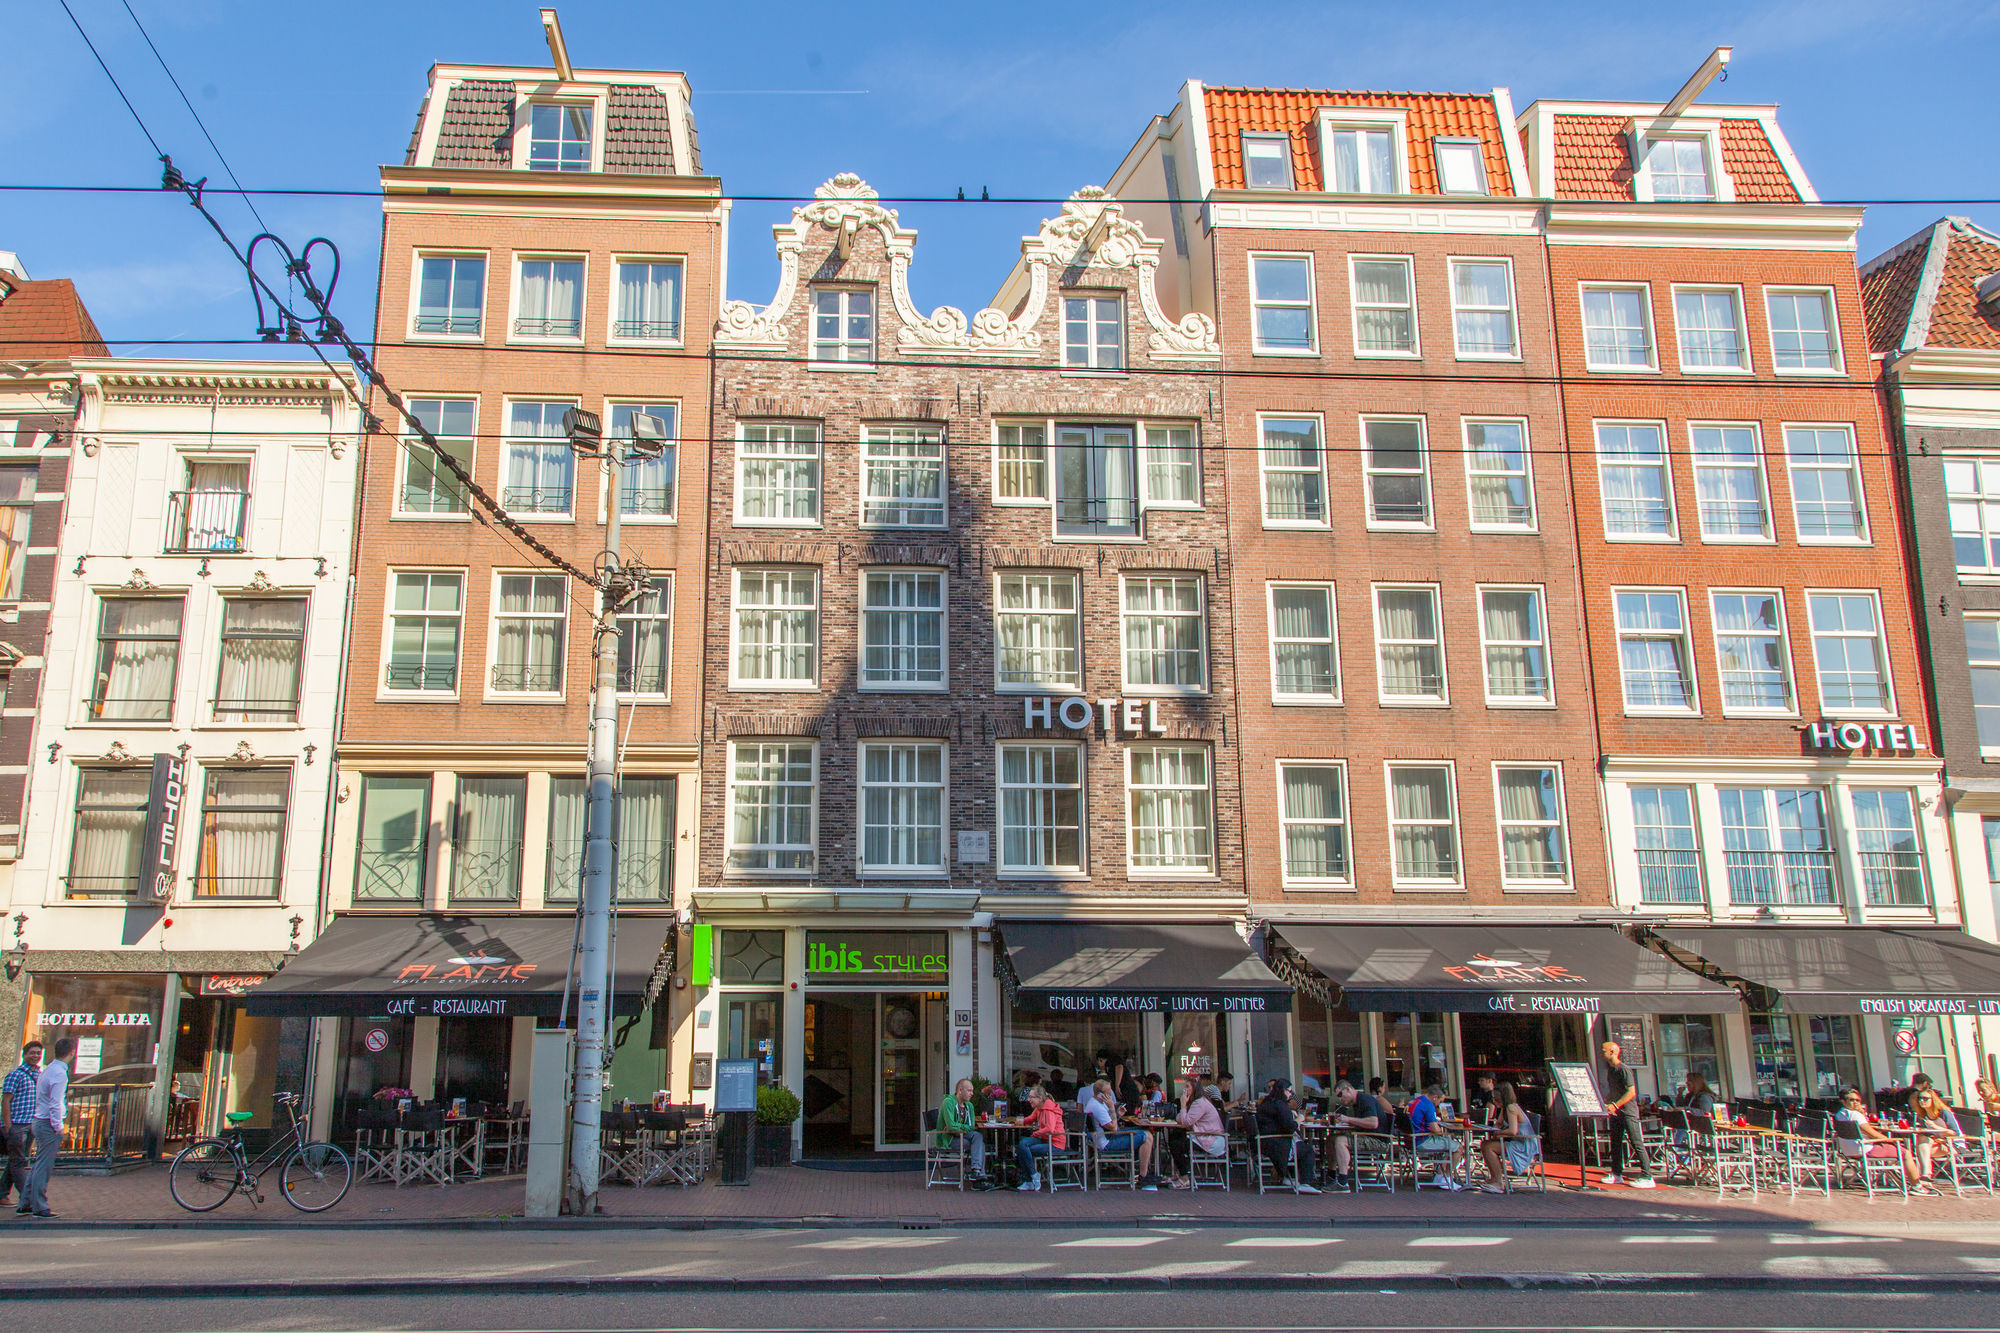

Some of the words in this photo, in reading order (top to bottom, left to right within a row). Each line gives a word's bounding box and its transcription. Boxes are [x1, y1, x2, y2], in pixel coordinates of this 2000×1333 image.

[1024, 697, 1167, 732] HOTEL
[1811, 722, 1927, 750] HOTEL
[159, 759, 184, 866] HOTEL
[809, 943, 863, 973] ibis
[396, 964, 538, 979] FLAME
[1442, 965, 1583, 979] FLAME
[387, 997, 415, 1014] CAFÉ
[433, 1000, 507, 1014] RESTAURANT
[1049, 996, 1095, 1010] ENGLISH
[1100, 996, 1158, 1010] BREAKFAST
[1172, 996, 1208, 1011] LUNCH
[1224, 997, 1265, 1011] DINNER
[1488, 995, 1516, 1011] CAFÉ
[1531, 997, 1600, 1011] RESTAURANT
[1860, 999, 1907, 1013] ENGLISH
[1908, 1000, 1967, 1013] BREAKFAST
[36, 1013, 96, 1026] HOTEL
[101, 1013, 152, 1026] ALFA
[957, 1014, 969, 1022] 10
[1181, 1055, 1210, 1066] FLAME
